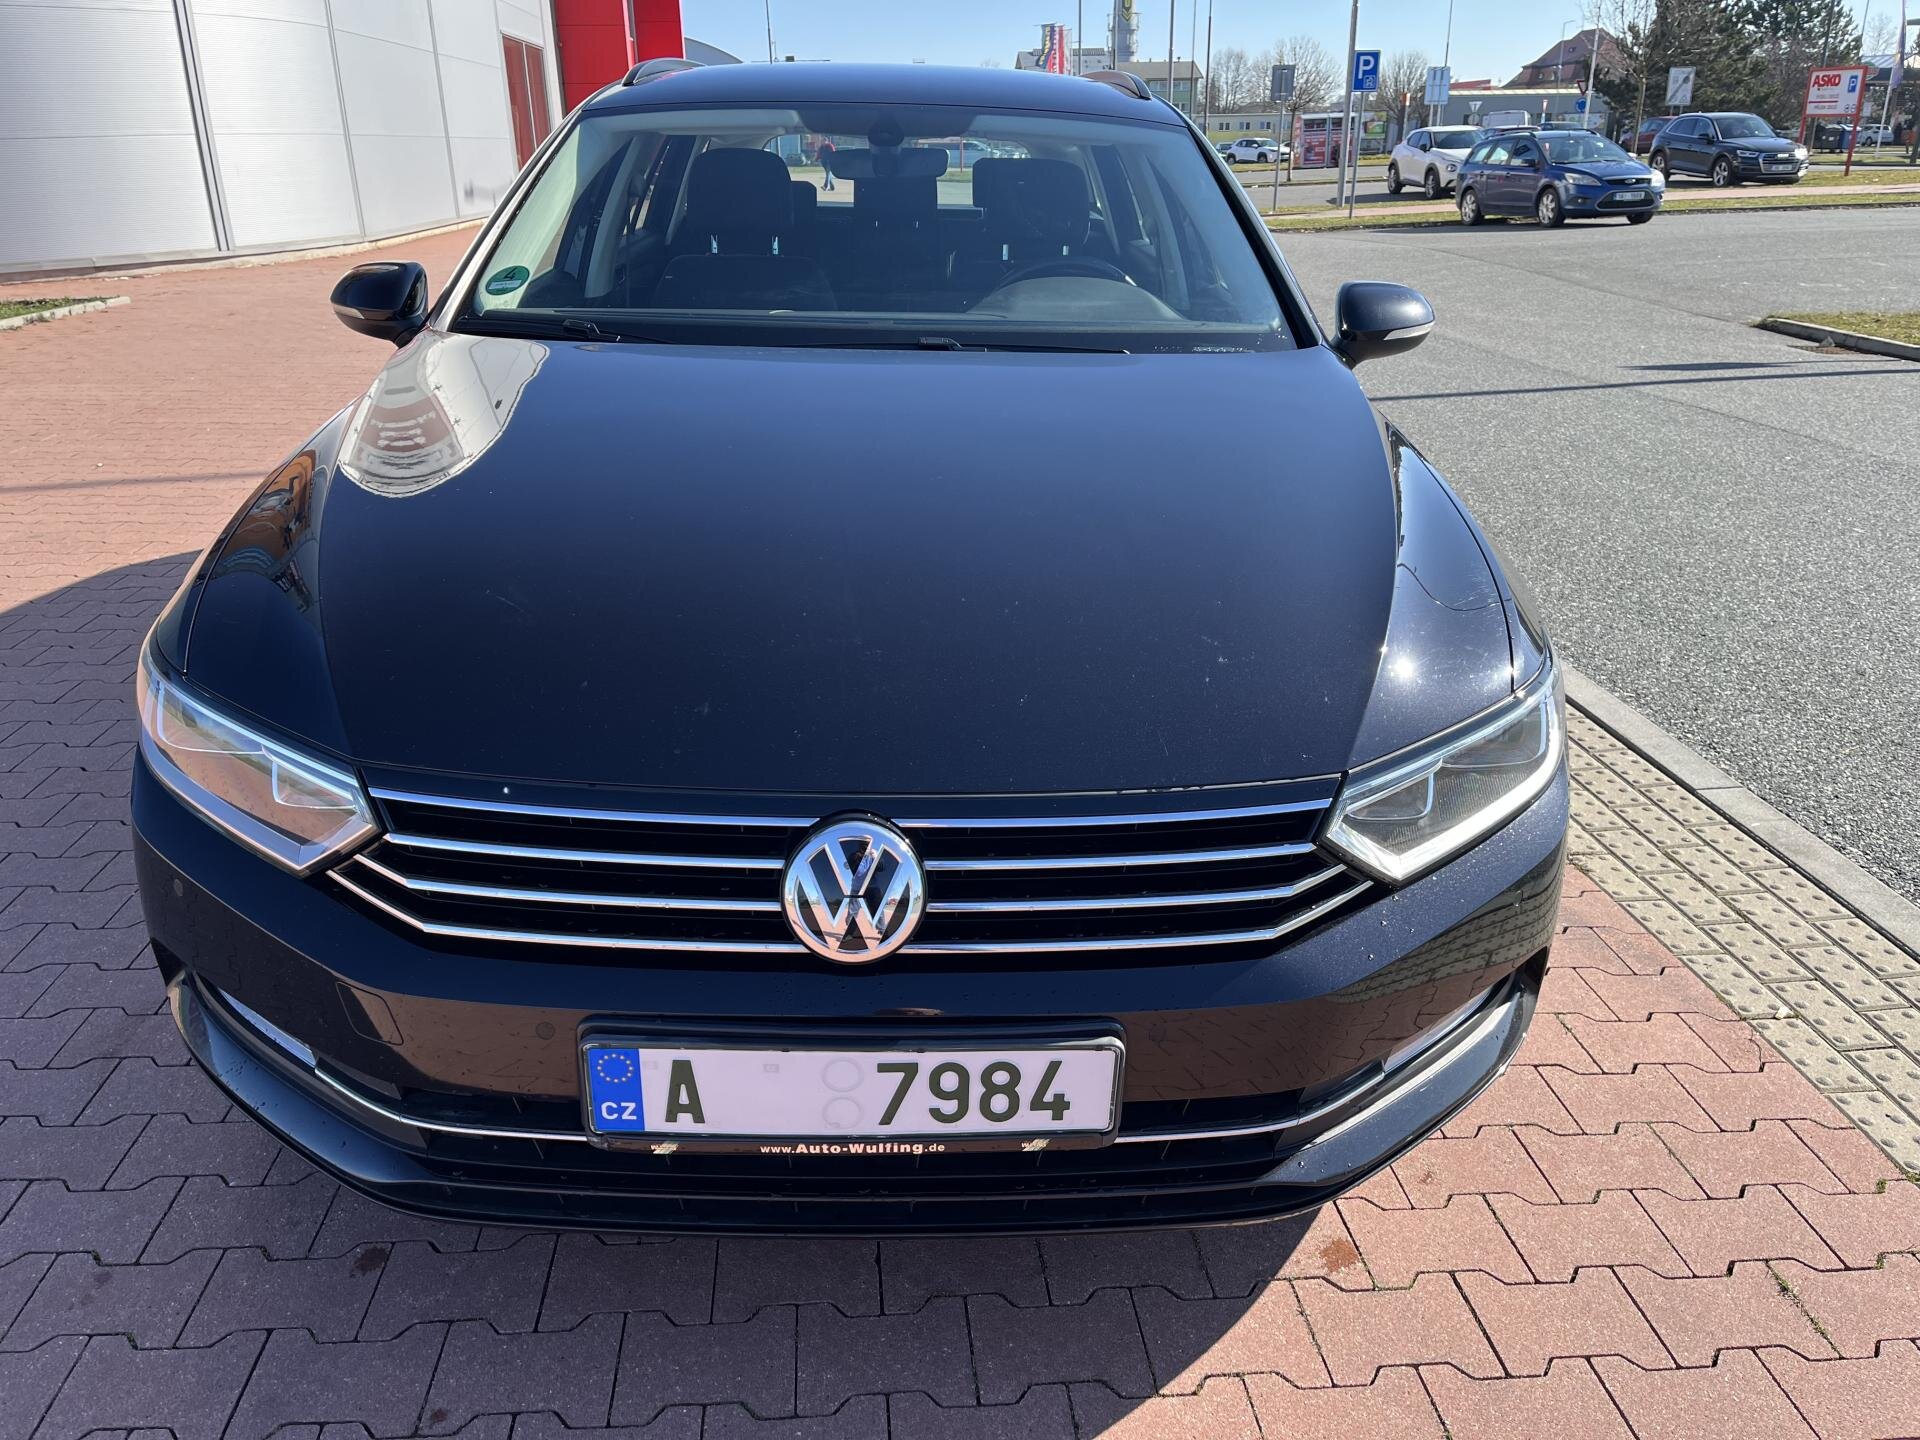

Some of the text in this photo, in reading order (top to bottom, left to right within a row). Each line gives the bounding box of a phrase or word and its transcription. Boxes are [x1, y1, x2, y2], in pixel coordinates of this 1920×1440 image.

[1358, 55, 1375, 79] P
[1812, 74, 1842, 87] ASKO
[1848, 78, 1857, 91] P
[503, 267, 517, 280] 4
[790, 828, 918, 957] VW
[601, 1059, 1071, 1126] CZ A 7984
[760, 1143, 945, 1155] www.Auto-Wulfing.de
